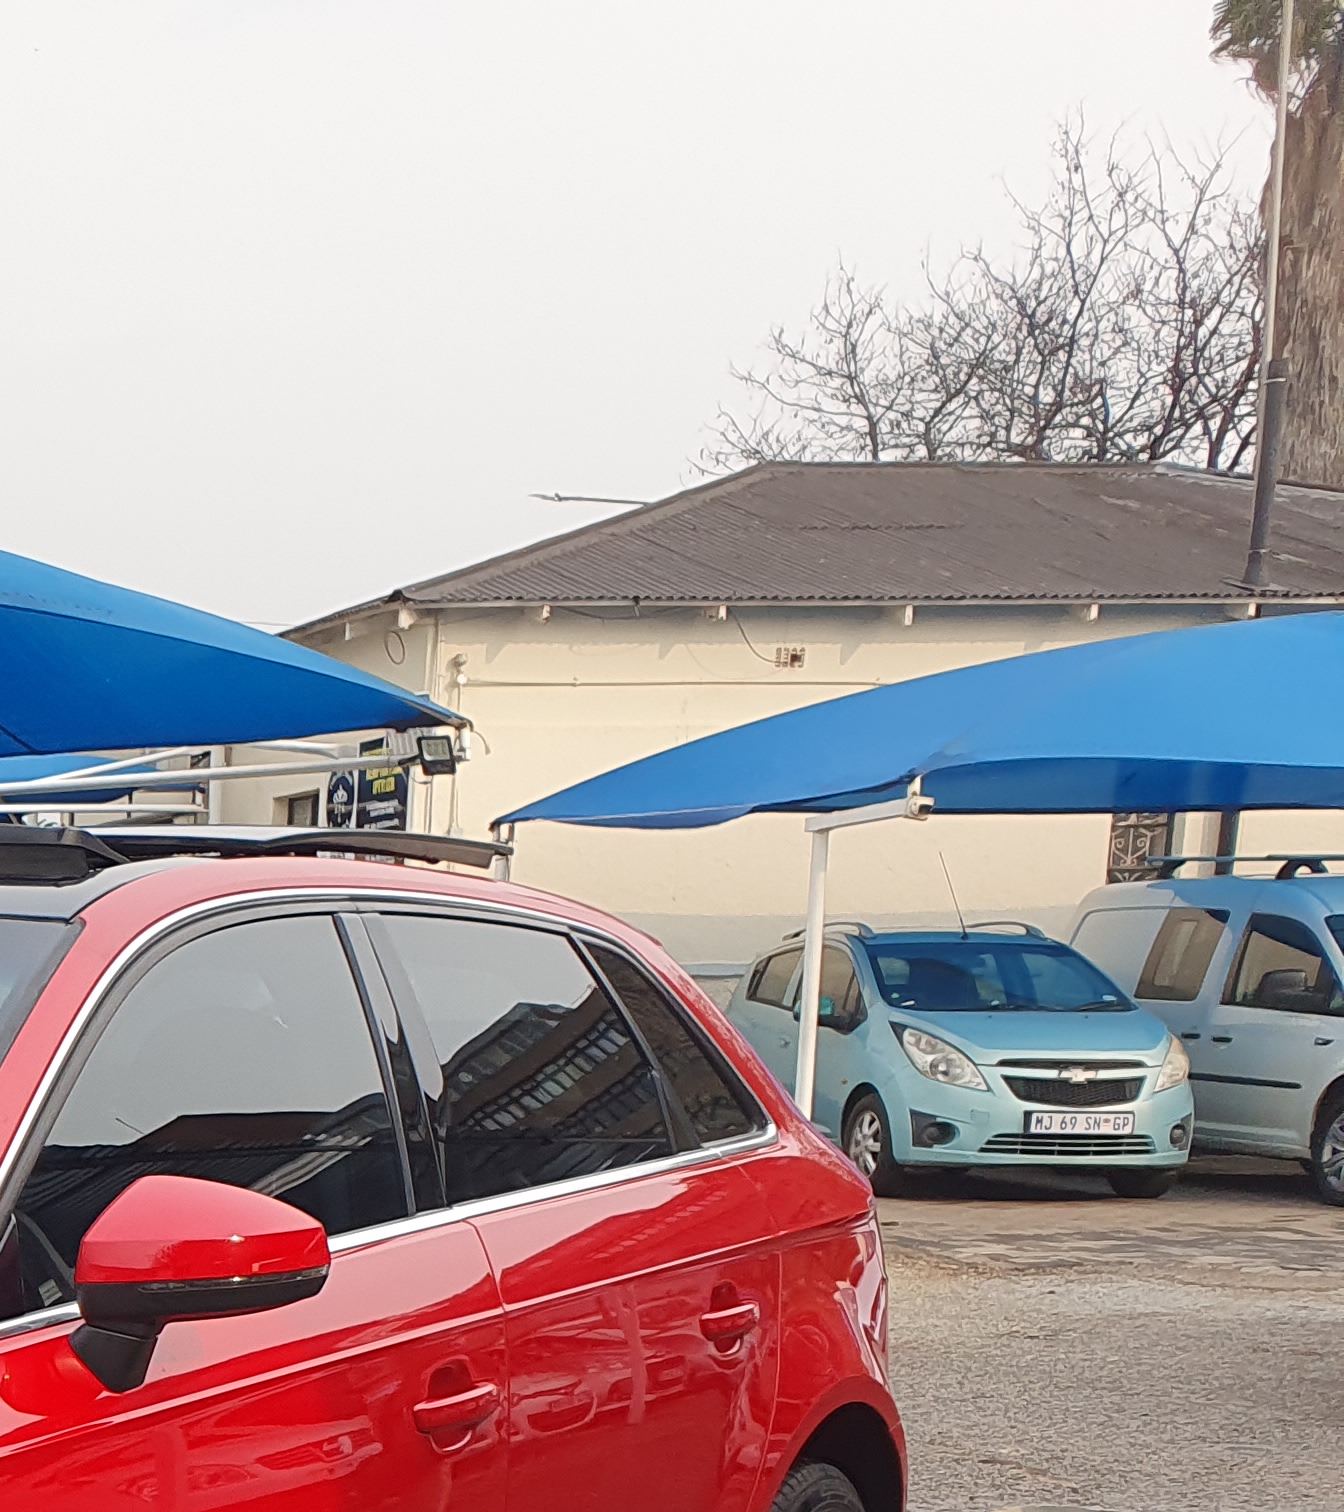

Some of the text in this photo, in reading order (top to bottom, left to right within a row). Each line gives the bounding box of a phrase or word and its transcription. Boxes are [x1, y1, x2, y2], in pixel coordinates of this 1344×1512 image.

[1059, 1115, 1078, 1131] 69
[1084, 1116, 1101, 1131] SN
[1112, 1116, 1130, 1132] GP
